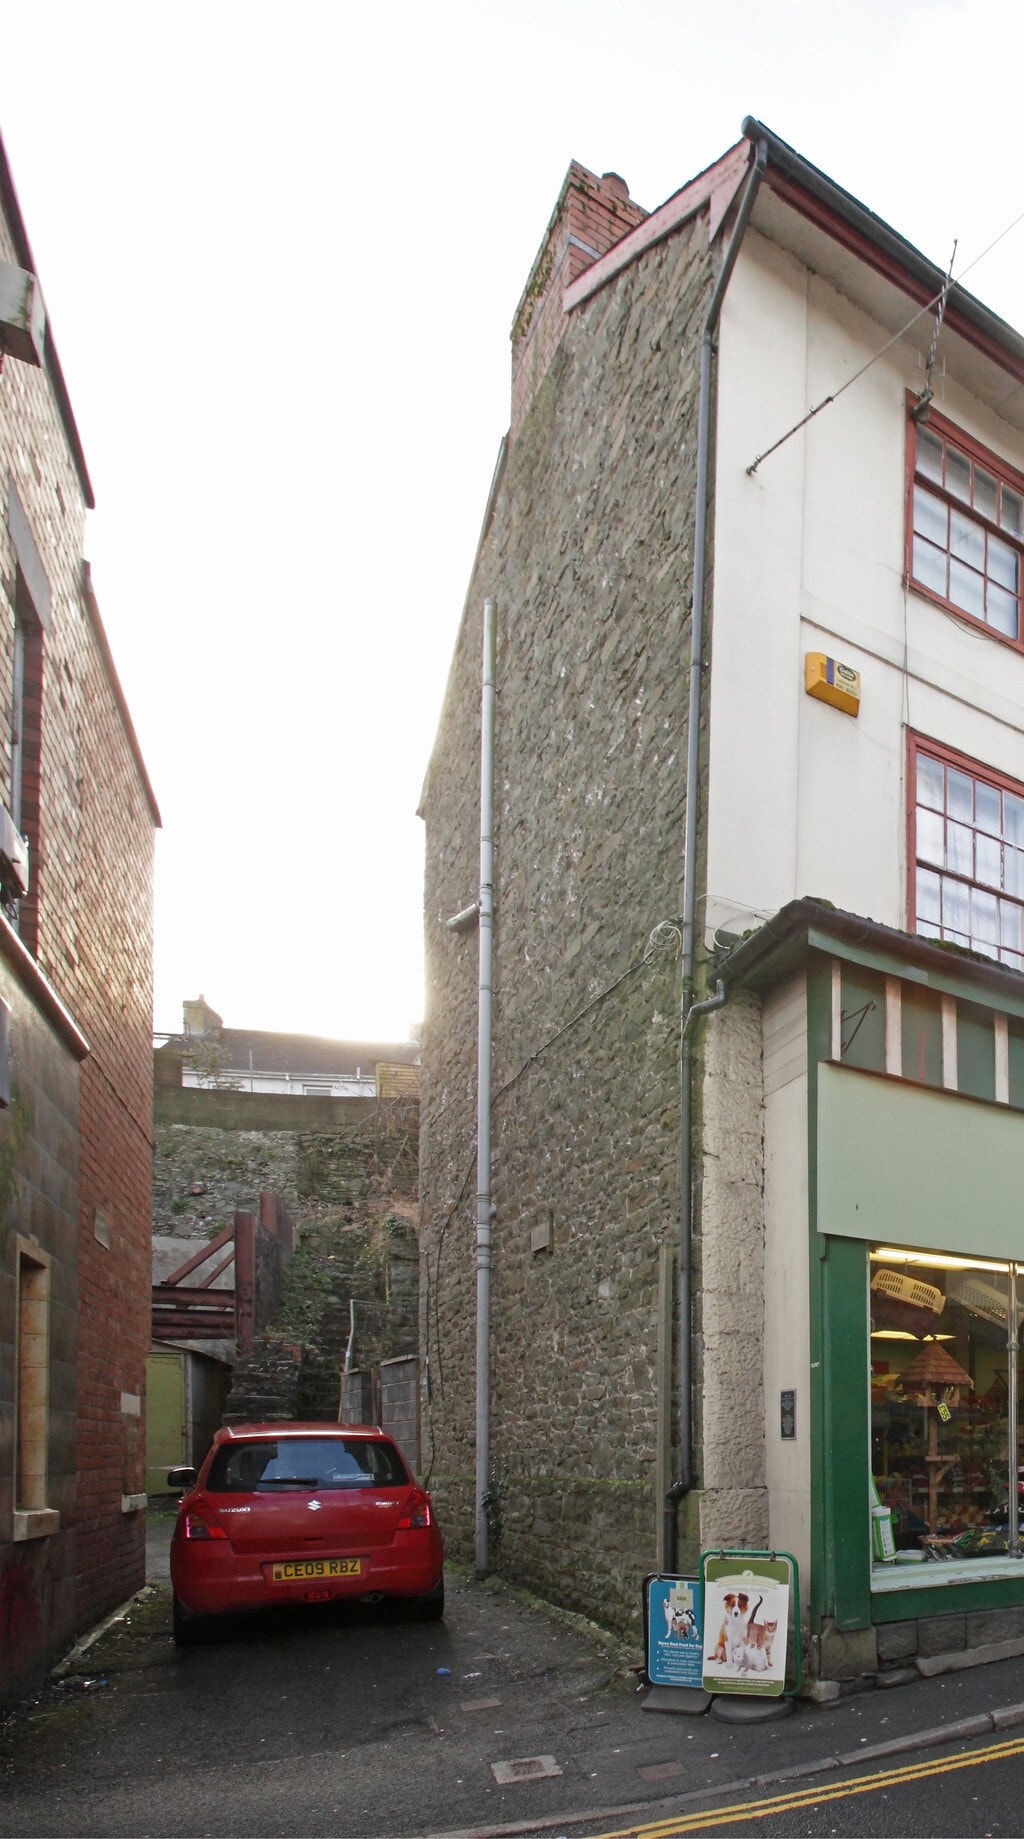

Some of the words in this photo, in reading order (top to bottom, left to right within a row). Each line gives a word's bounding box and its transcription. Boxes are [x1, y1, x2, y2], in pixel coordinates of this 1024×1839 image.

[939, 1405, 950, 1420] £55
[283, 1560, 325, 1578] CE09
[328, 1558, 359, 1576] RBZ
